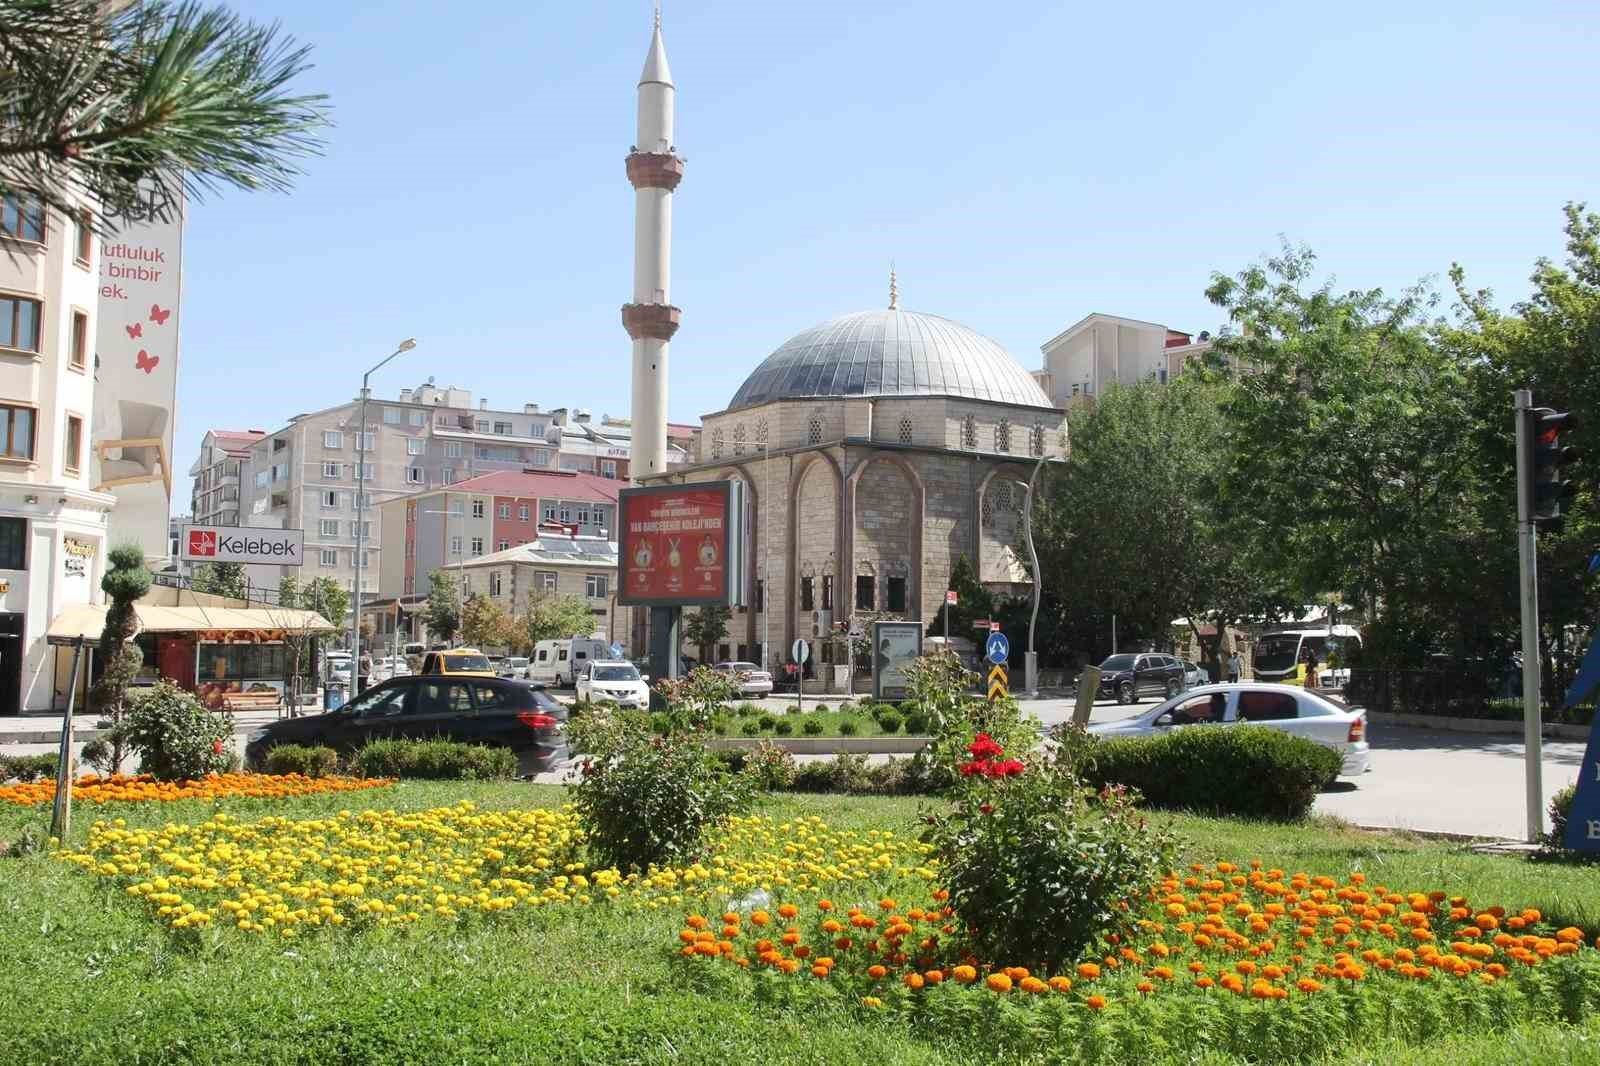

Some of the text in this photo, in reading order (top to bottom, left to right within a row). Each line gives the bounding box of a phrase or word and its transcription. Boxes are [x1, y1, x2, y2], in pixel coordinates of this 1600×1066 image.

[100, 243, 165, 263] utluluk
[108, 262, 162, 282] binbir
[218, 535, 296, 556] Kelebek
